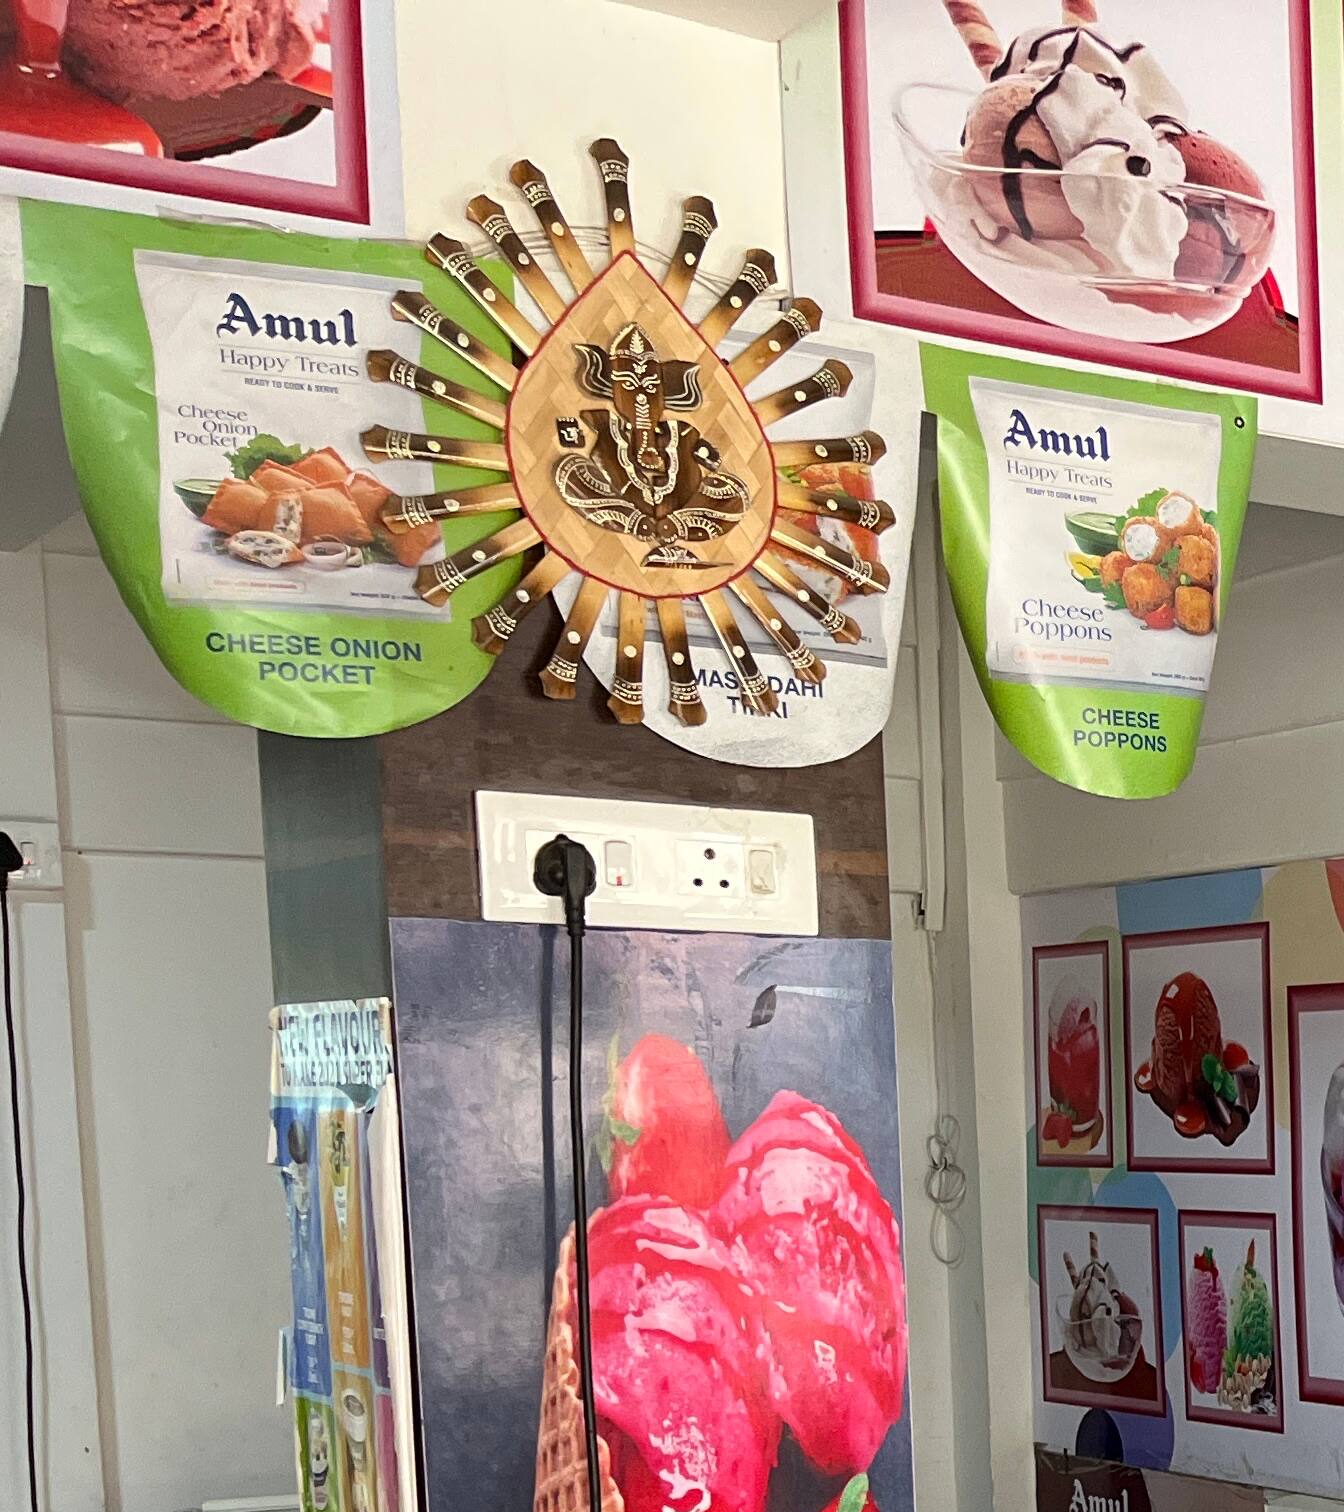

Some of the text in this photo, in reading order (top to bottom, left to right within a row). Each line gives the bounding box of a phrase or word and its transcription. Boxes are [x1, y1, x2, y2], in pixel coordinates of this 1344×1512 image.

[216, 292, 358, 347] Amul
[220, 349, 360, 378] Happy Treats
[244, 377, 270, 388] READY
[271, 379, 282, 389] TO
[284, 382, 305, 391] COOK
[177, 404, 248, 422] Cheese
[173, 430, 237, 448] Pocket
[202, 419, 258, 436] Onion
[1003, 409, 1111, 462] Amul
[1007, 458, 1114, 490] Happy Treats
[1021, 598, 1104, 623] Cheese
[1014, 616, 1113, 642] Poppons
[205, 631, 422, 662] CHEESE ONION
[259, 660, 376, 685] POCKET
[766, 672, 823, 698] DAHI
[1081, 707, 1160, 730] CHEESE
[1072, 730, 1168, 753] POPPONS
